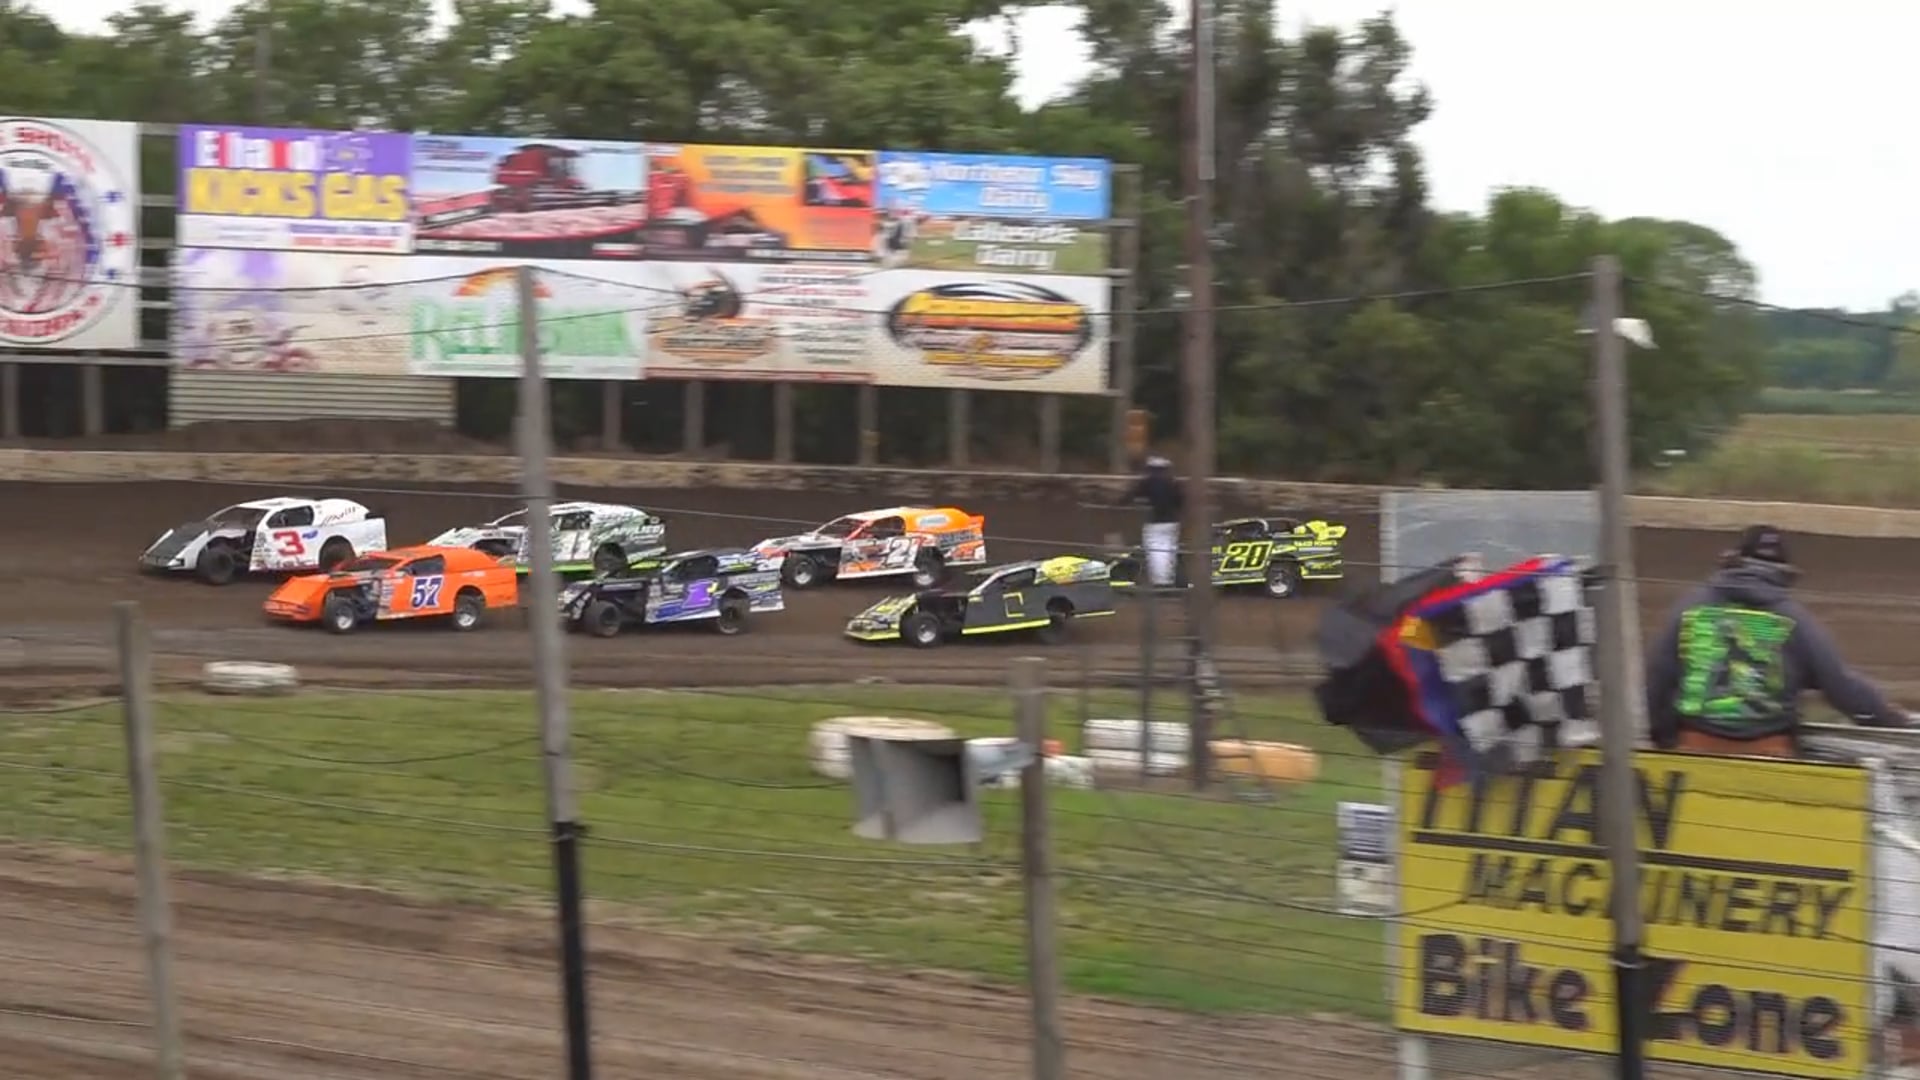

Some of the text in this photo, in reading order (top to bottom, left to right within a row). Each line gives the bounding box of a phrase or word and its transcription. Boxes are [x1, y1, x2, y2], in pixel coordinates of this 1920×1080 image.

[187, 167, 407, 221] KICKS GAS
[273, 529, 305, 556] 3
[1219, 541, 1273, 572] 20
[412, 576, 444, 609] 57
[1466, 851, 1853, 940] MACINERY
[1419, 933, 1592, 1032] Bike
